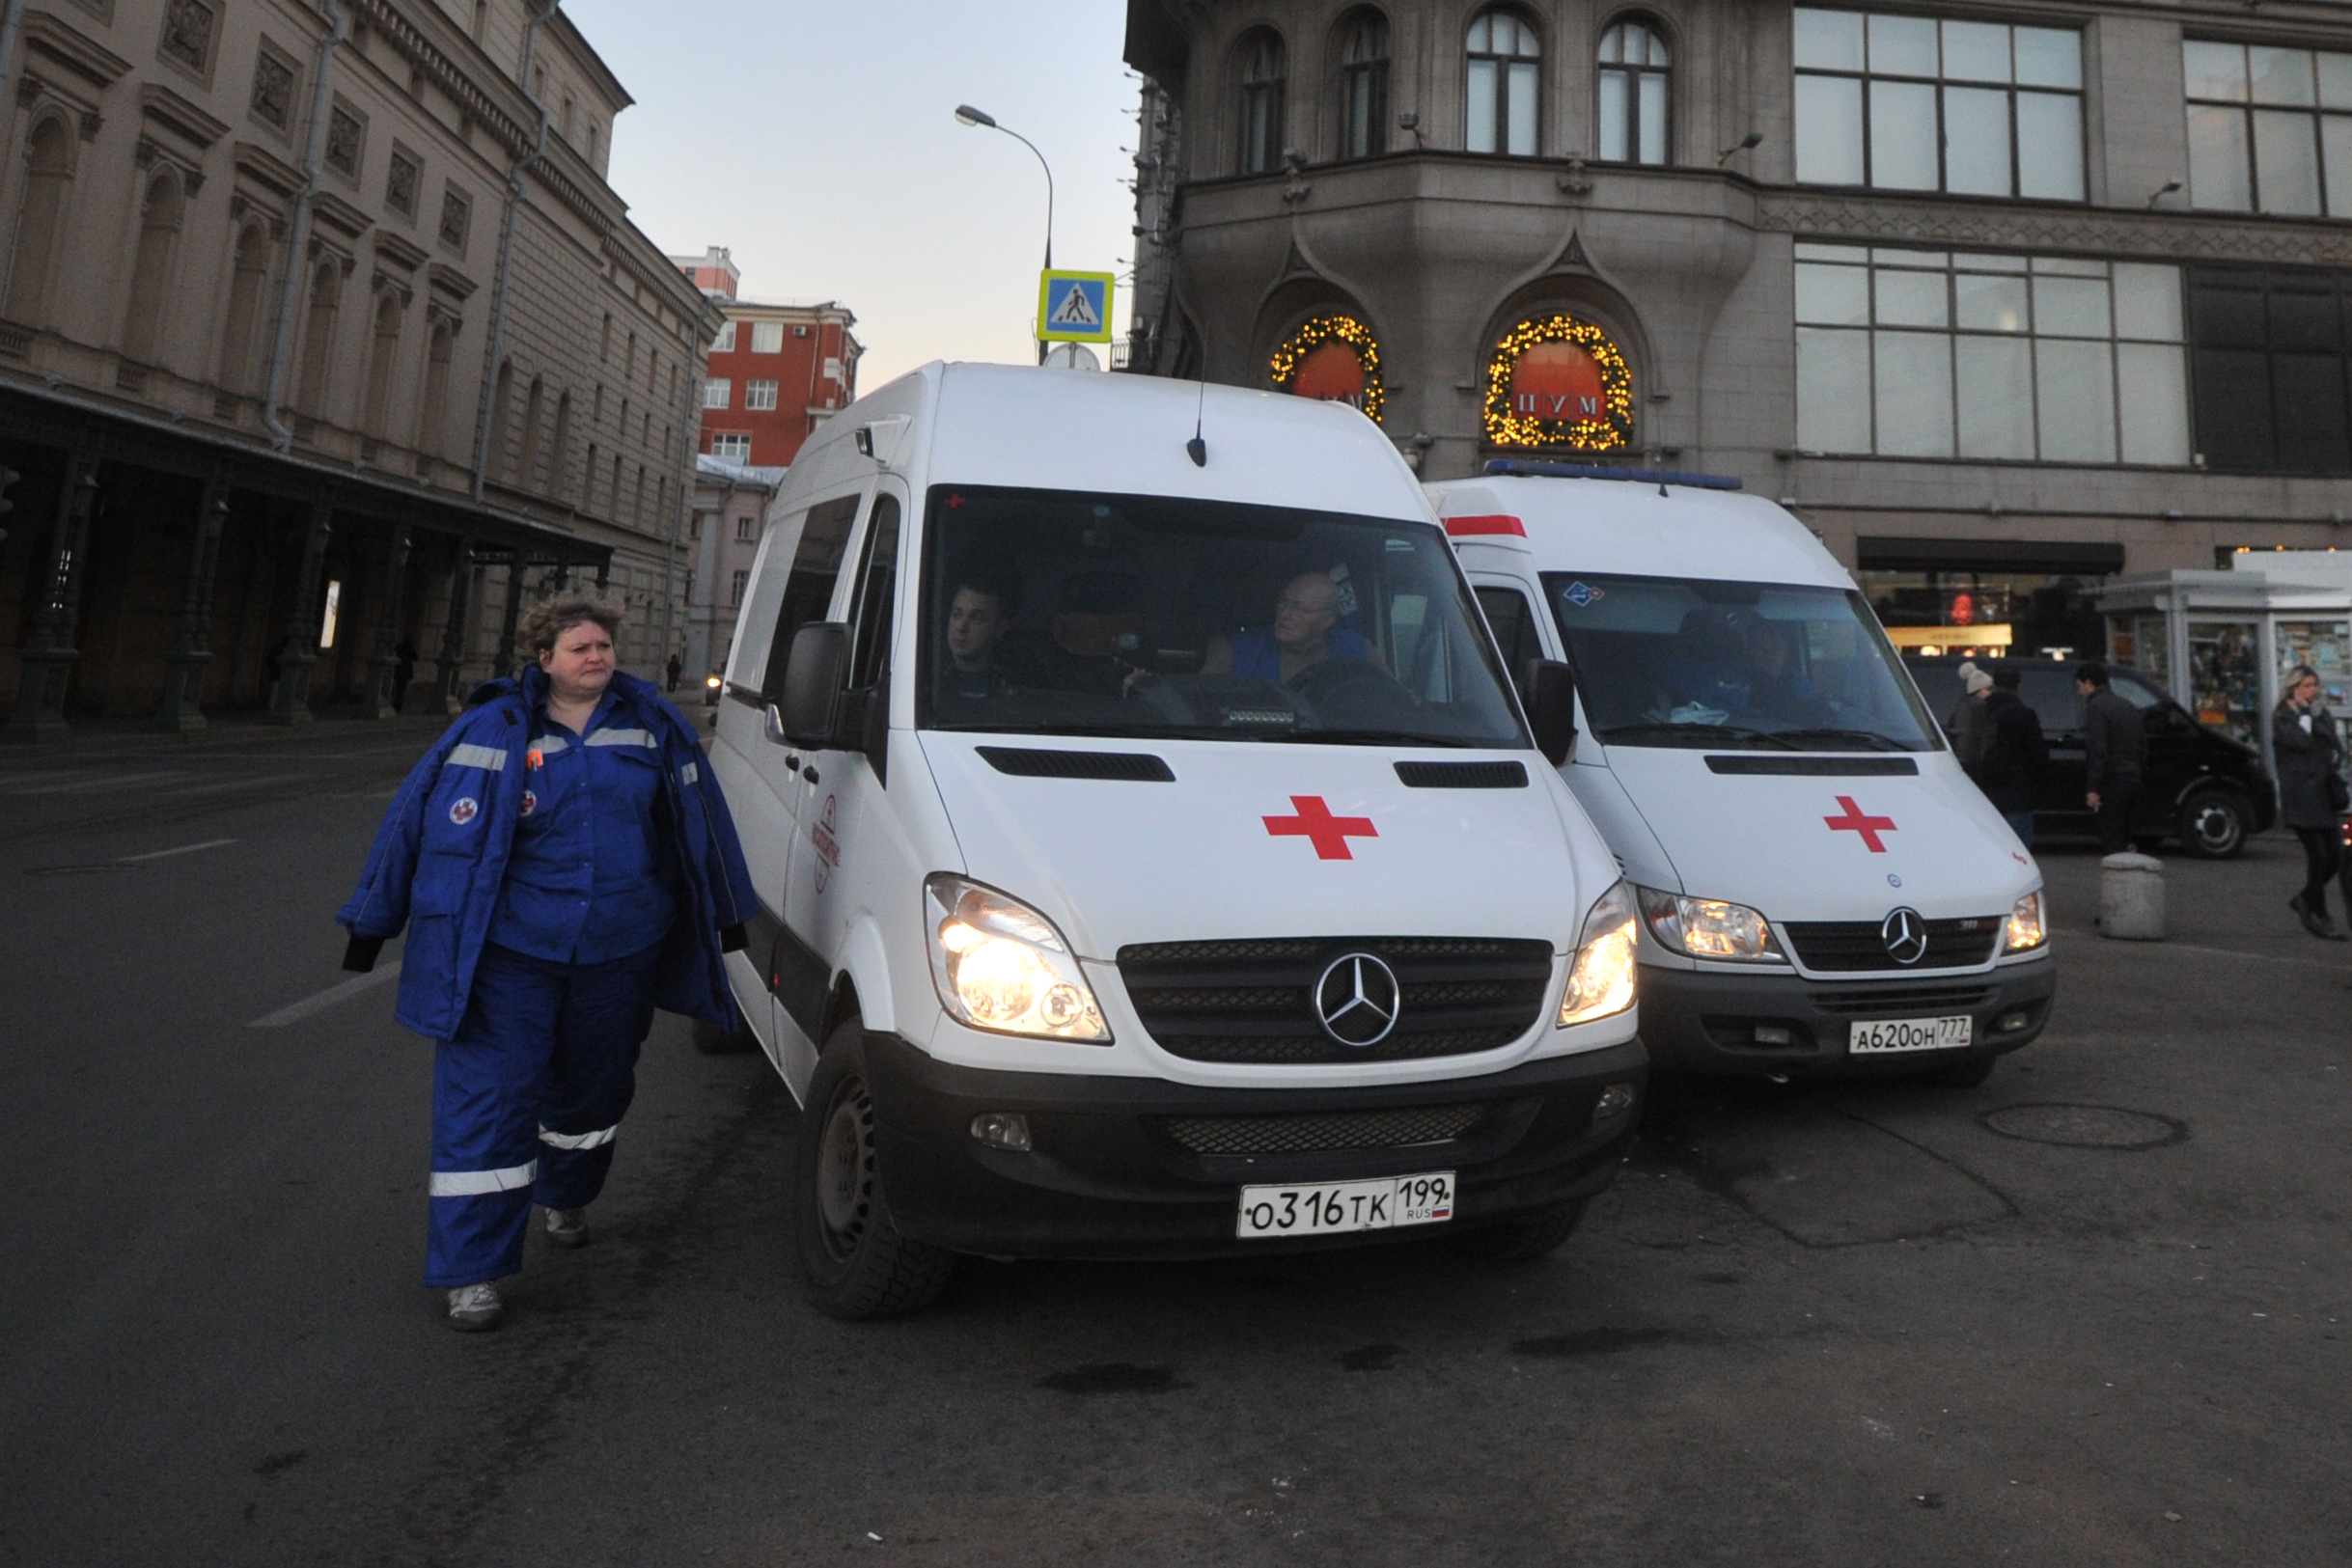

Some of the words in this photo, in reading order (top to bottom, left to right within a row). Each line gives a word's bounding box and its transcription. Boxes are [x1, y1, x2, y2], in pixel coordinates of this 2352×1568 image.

[1857, 1023, 1935, 1050] А620ОН
[1941, 1018, 1967, 1037] 777
[1251, 1190, 1389, 1230] О316ТК
[1399, 1177, 1446, 1207] 199
[1406, 1208, 1431, 1220] RUS
